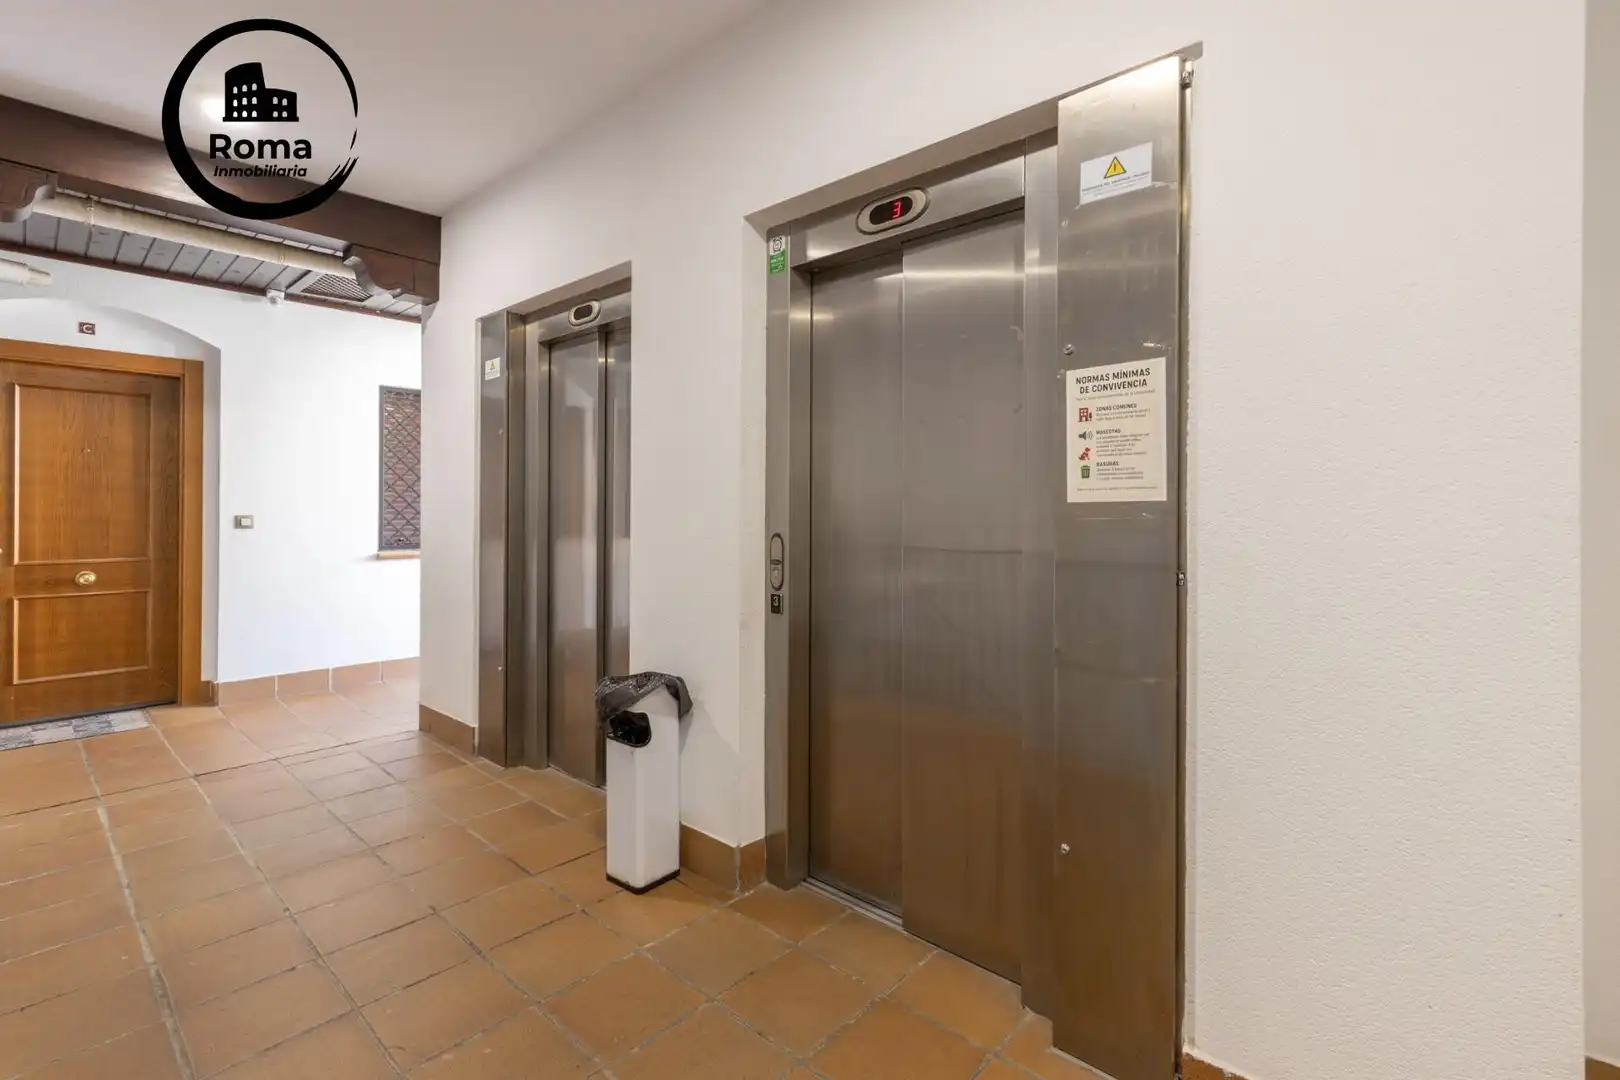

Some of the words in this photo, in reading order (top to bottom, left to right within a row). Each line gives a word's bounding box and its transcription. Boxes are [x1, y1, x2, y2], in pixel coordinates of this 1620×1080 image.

[892, 201, 903, 219] 3
[1075, 373, 1110, 385] NORMAS
[1112, 367, 1151, 380] MÍNIMAS
[1080, 386, 1090, 394] DE
[1091, 378, 1148, 393] CONVIVENCIA
[772, 595, 780, 606] 3
